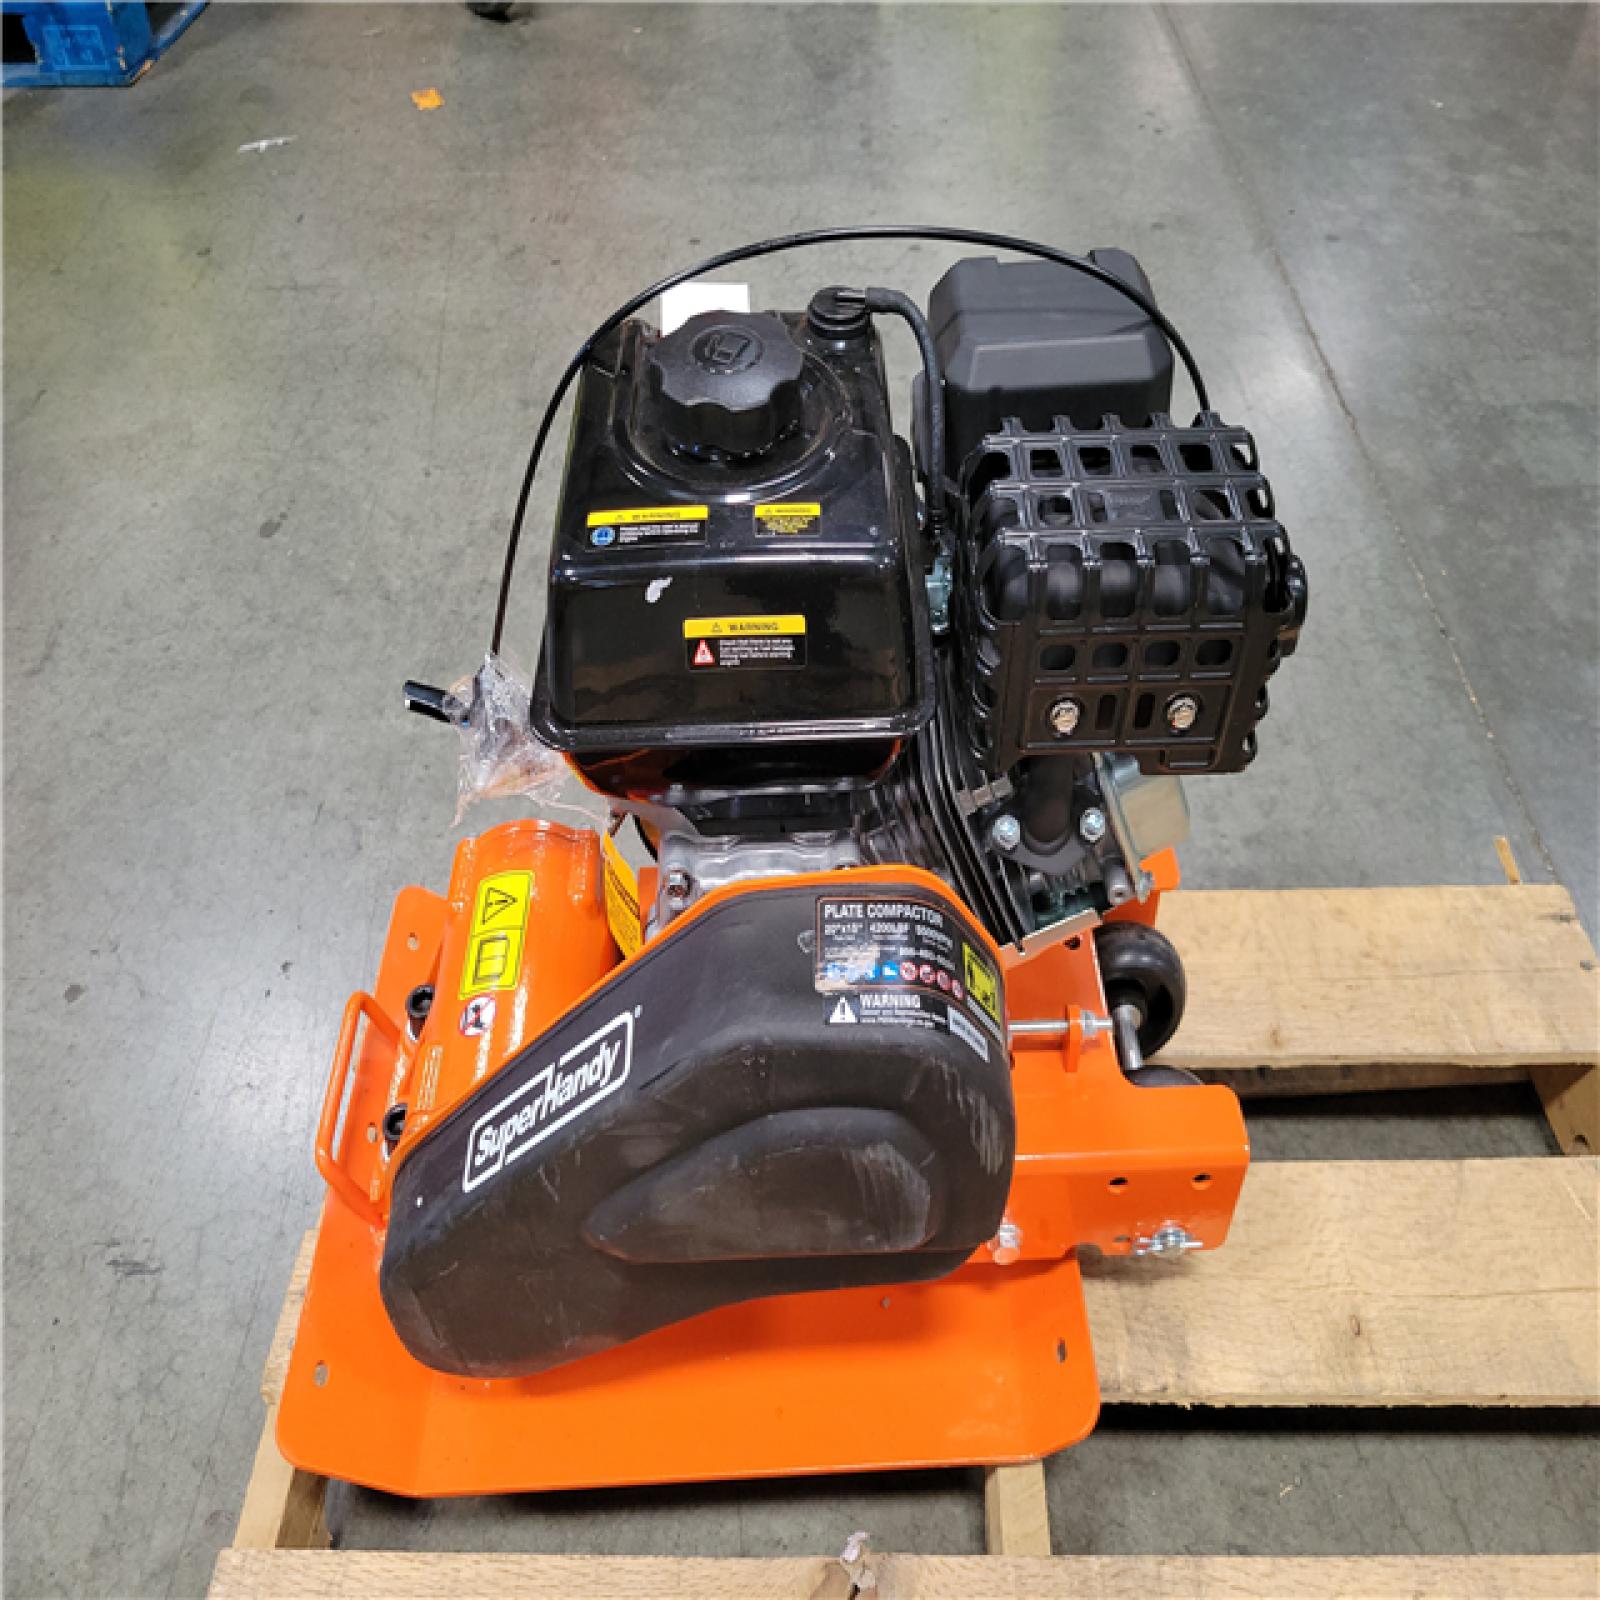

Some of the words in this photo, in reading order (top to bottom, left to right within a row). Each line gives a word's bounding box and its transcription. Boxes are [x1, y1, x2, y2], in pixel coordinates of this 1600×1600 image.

[728, 622, 779, 631] WARNING
[824, 903, 863, 918] PLATE
[866, 903, 943, 928] COMPACTOR
[859, 994, 921, 1009] WARNING
[474, 1040, 622, 1166] SuperHandy
